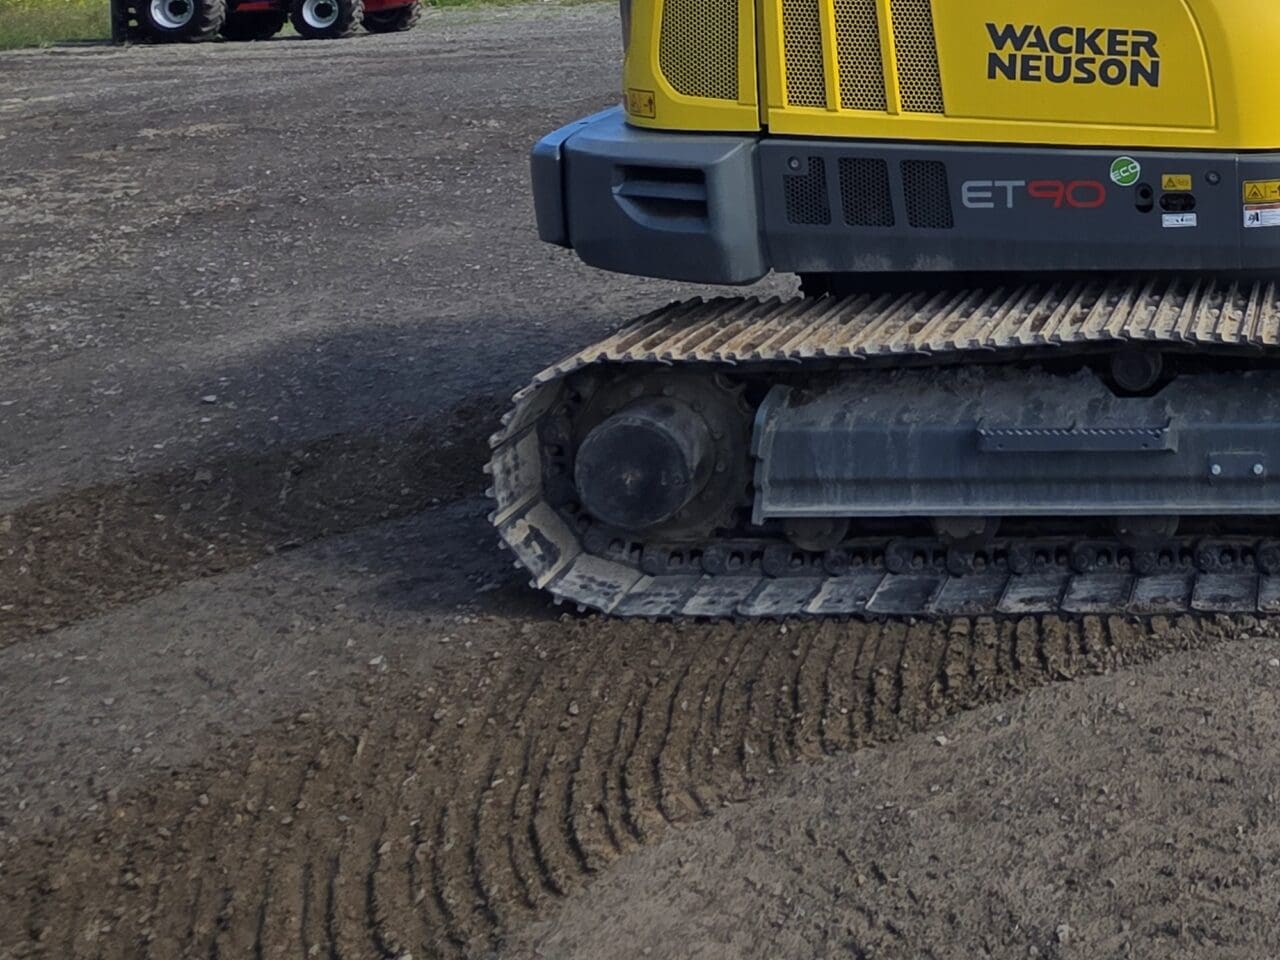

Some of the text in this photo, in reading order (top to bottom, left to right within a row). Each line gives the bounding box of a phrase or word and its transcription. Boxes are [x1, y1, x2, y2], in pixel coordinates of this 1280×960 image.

[985, 23, 1160, 58] WACKER
[987, 52, 1160, 88] NEUSON
[1110, 162, 1141, 182] ECO
[961, 180, 1106, 209] ET90
